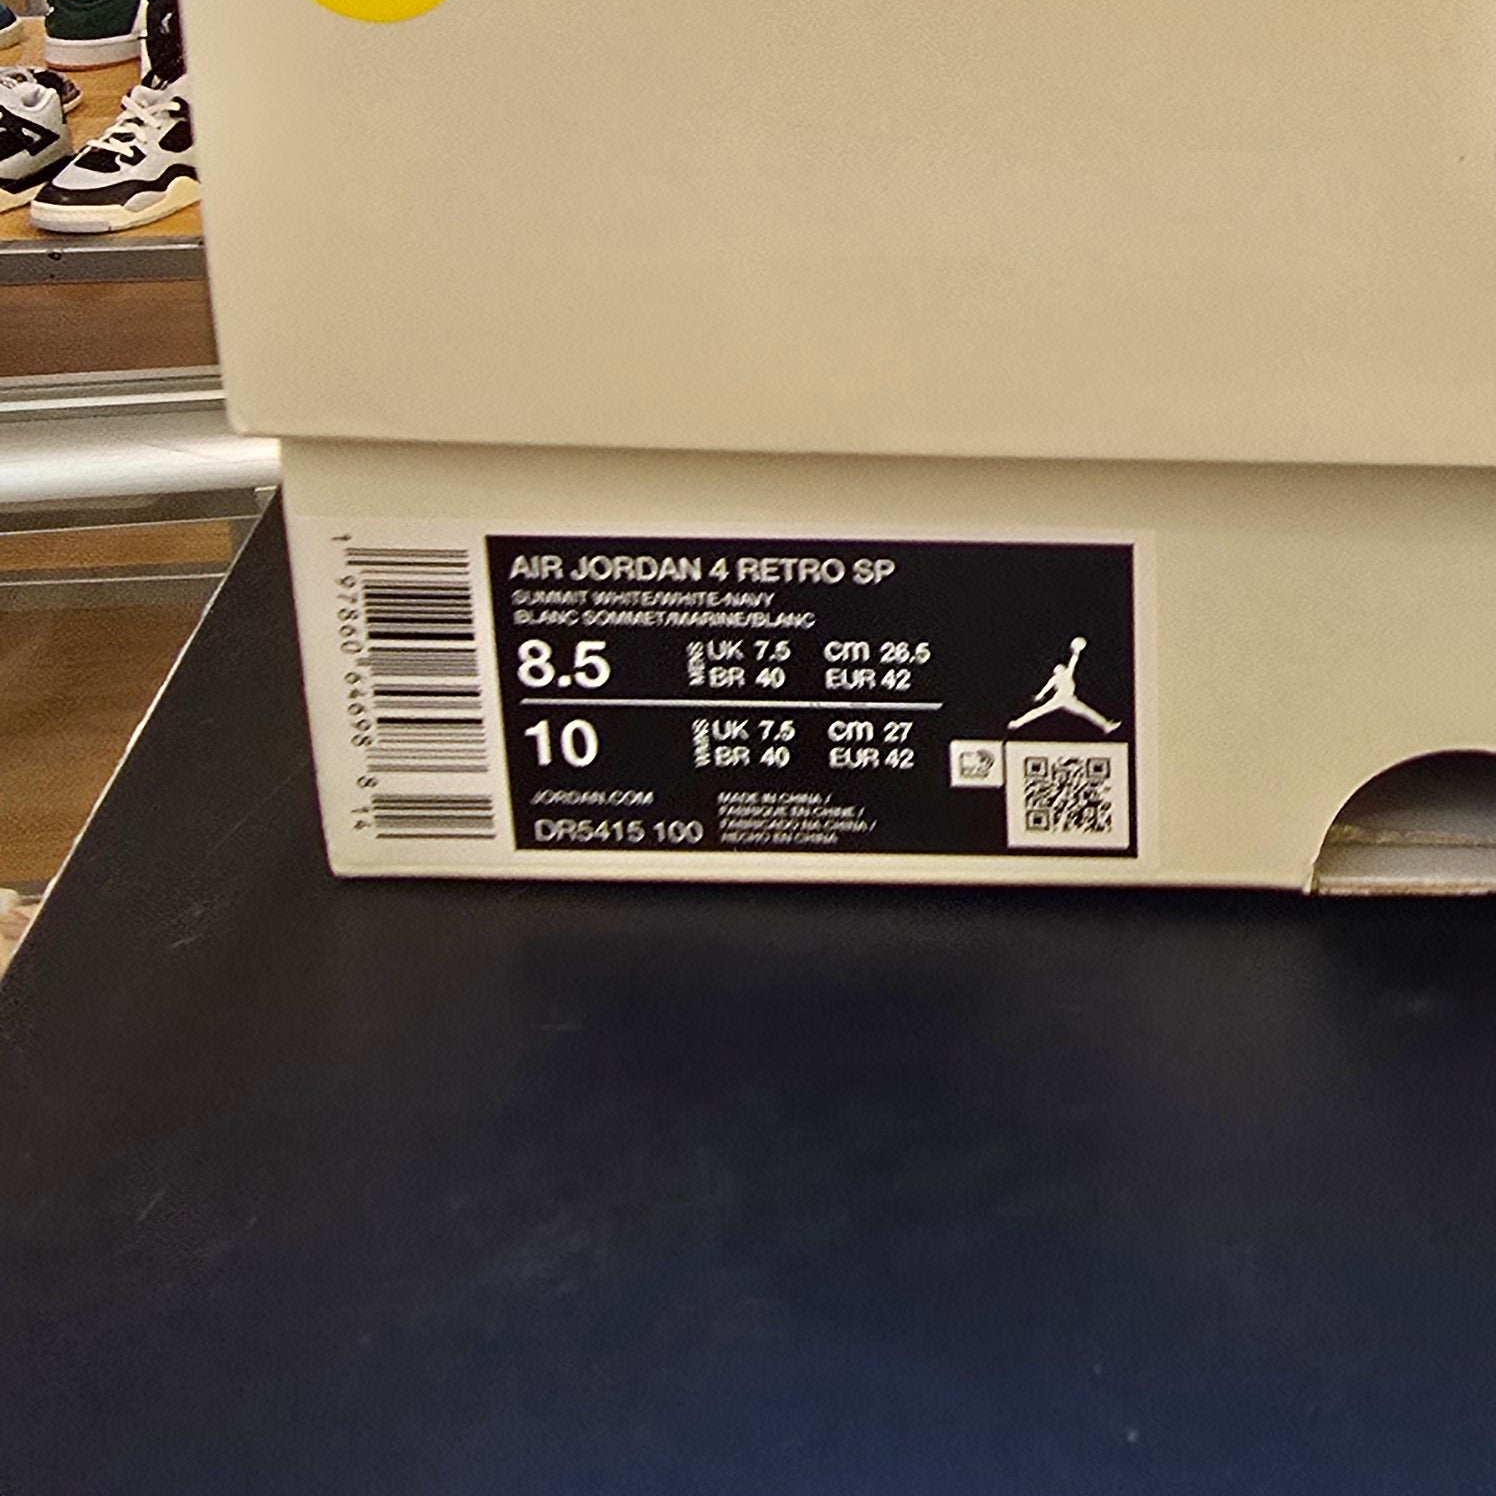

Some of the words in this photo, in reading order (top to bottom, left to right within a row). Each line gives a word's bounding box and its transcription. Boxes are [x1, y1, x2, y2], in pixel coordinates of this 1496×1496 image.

[509, 554, 563, 581] AIR
[570, 555, 700, 582] JORDAN
[709, 556, 730, 582] 4
[736, 557, 845, 584] RETRO
[852, 558, 897, 585] SP
[513, 609, 580, 626] BLANC
[516, 637, 611, 689] 8.5
[707, 639, 744, 661] UK
[753, 640, 791, 662] 7.5
[823, 640, 870, 662] cm
[880, 641, 931, 664] 26.5
[708, 666, 746, 689] BR
[754, 666, 786, 689] 40
[824, 667, 876, 690] EUR
[881, 668, 912, 691] 42
[523, 718, 599, 768] 10
[712, 719, 749, 741] UK
[758, 720, 796, 742] 7.5
[827, 720, 874, 742] cm
[883, 720, 913, 743] 27
[714, 745, 750, 767] BR
[760, 746, 791, 768] 40
[829, 747, 880, 769] EUR
[884, 747, 915, 770] 42
[530, 790, 655, 806] JORDAN.COM
[534, 819, 645, 843] DR5415
[653, 820, 704, 845] 100
